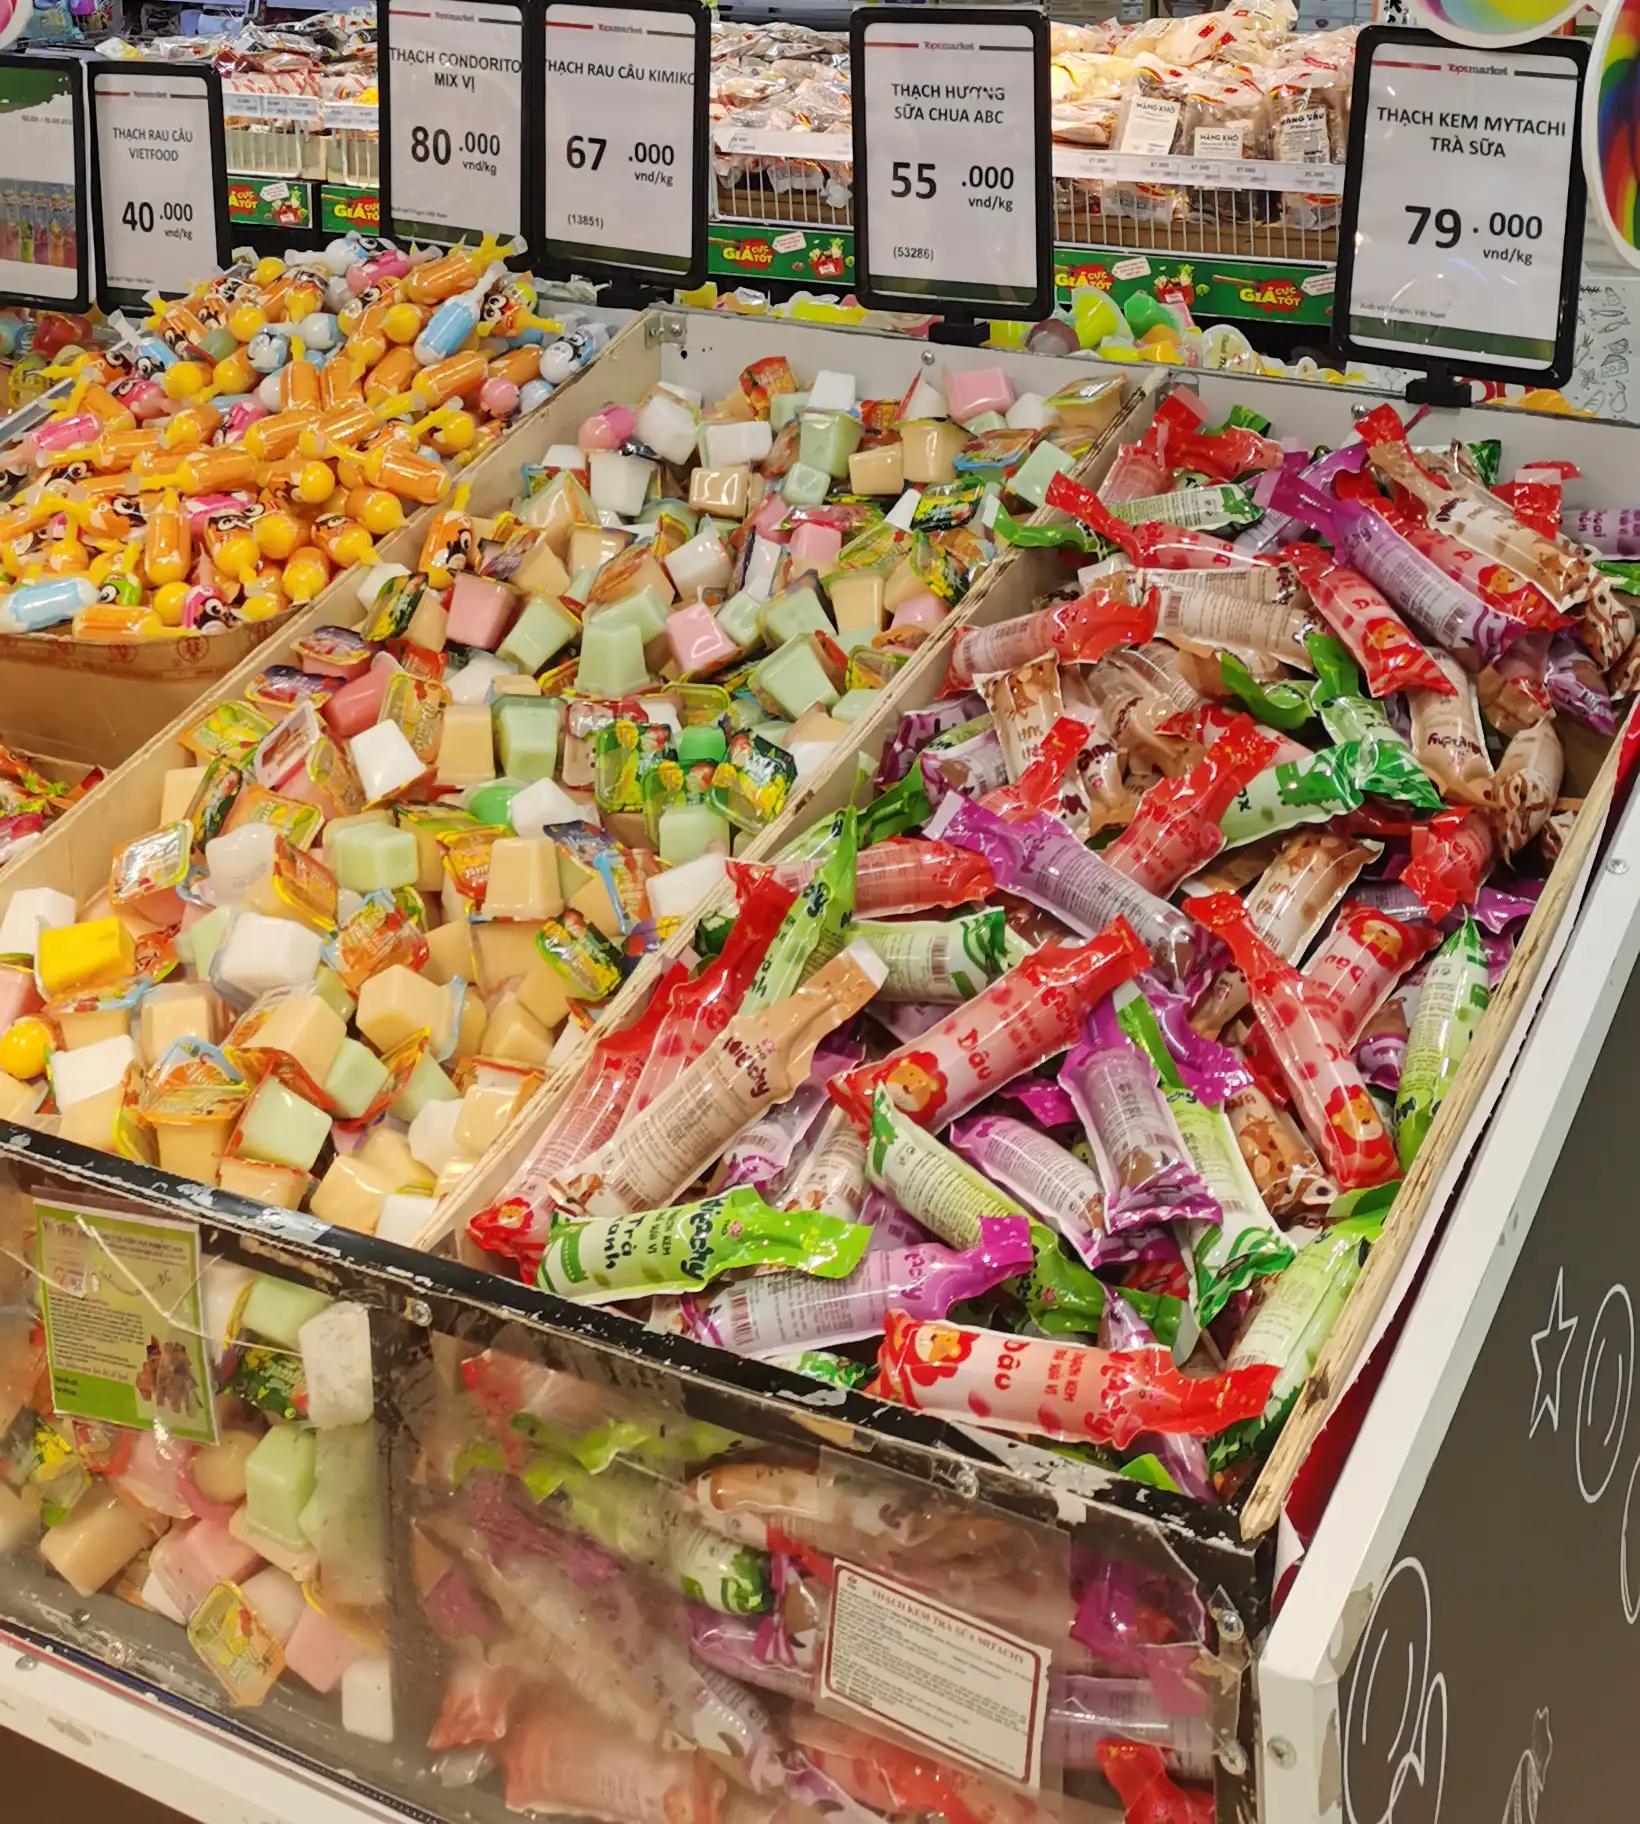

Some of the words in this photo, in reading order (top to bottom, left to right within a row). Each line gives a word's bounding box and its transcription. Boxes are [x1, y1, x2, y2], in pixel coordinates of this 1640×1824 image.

[389, 47, 435, 65] THẠCH
[438, 52, 522, 74] CONDORITO
[1447, 62, 1509, 77] Topsmarket
[587, 64, 615, 78] RAU
[618, 63, 646, 81] CÂU
[434, 72, 459, 89] MIX
[461, 75, 476, 94] VỊ
[891, 83, 941, 101] THẠCH
[894, 104, 925, 122] SỮA
[928, 107, 969, 123] CHUA
[973, 108, 1004, 125] ABC
[1377, 106, 1434, 127] THẠCH
[1438, 112, 1479, 130] KEM
[1484, 117, 1566, 137] MYTACHI
[112, 126, 146, 142] THẠCH
[148, 129, 169, 141] RAU
[1430, 131, 1464, 154] TRÀ
[1469, 138, 1506, 158] SỮA
[128, 148, 179, 162] VIETFOOD
[411, 126, 452, 166] 80
[458, 131, 501, 157] .000
[566, 135, 608, 171] 67
[628, 142, 675, 166] .000
[462, 160, 498, 176] vnd/kg
[634, 171, 674, 187] vnd/kg
[890, 161, 938, 200] 55
[961, 165, 1015, 190] .000
[968, 195, 1013, 213] vnd/kg
[121, 200, 155, 234] 40
[159, 201, 194, 223] .000
[567, 213, 605, 230] (13851)
[1404, 204, 1462, 249] 79
[164, 227, 193, 241] vnd/kg
[892, 246, 935, 262] (53286)
[1482, 248, 1533, 266] vnd/kg
[957, 1027, 992, 1081] Dâu
[620, 1214, 648, 1257] Trà
[994, 1339, 1032, 1391] Dâu
